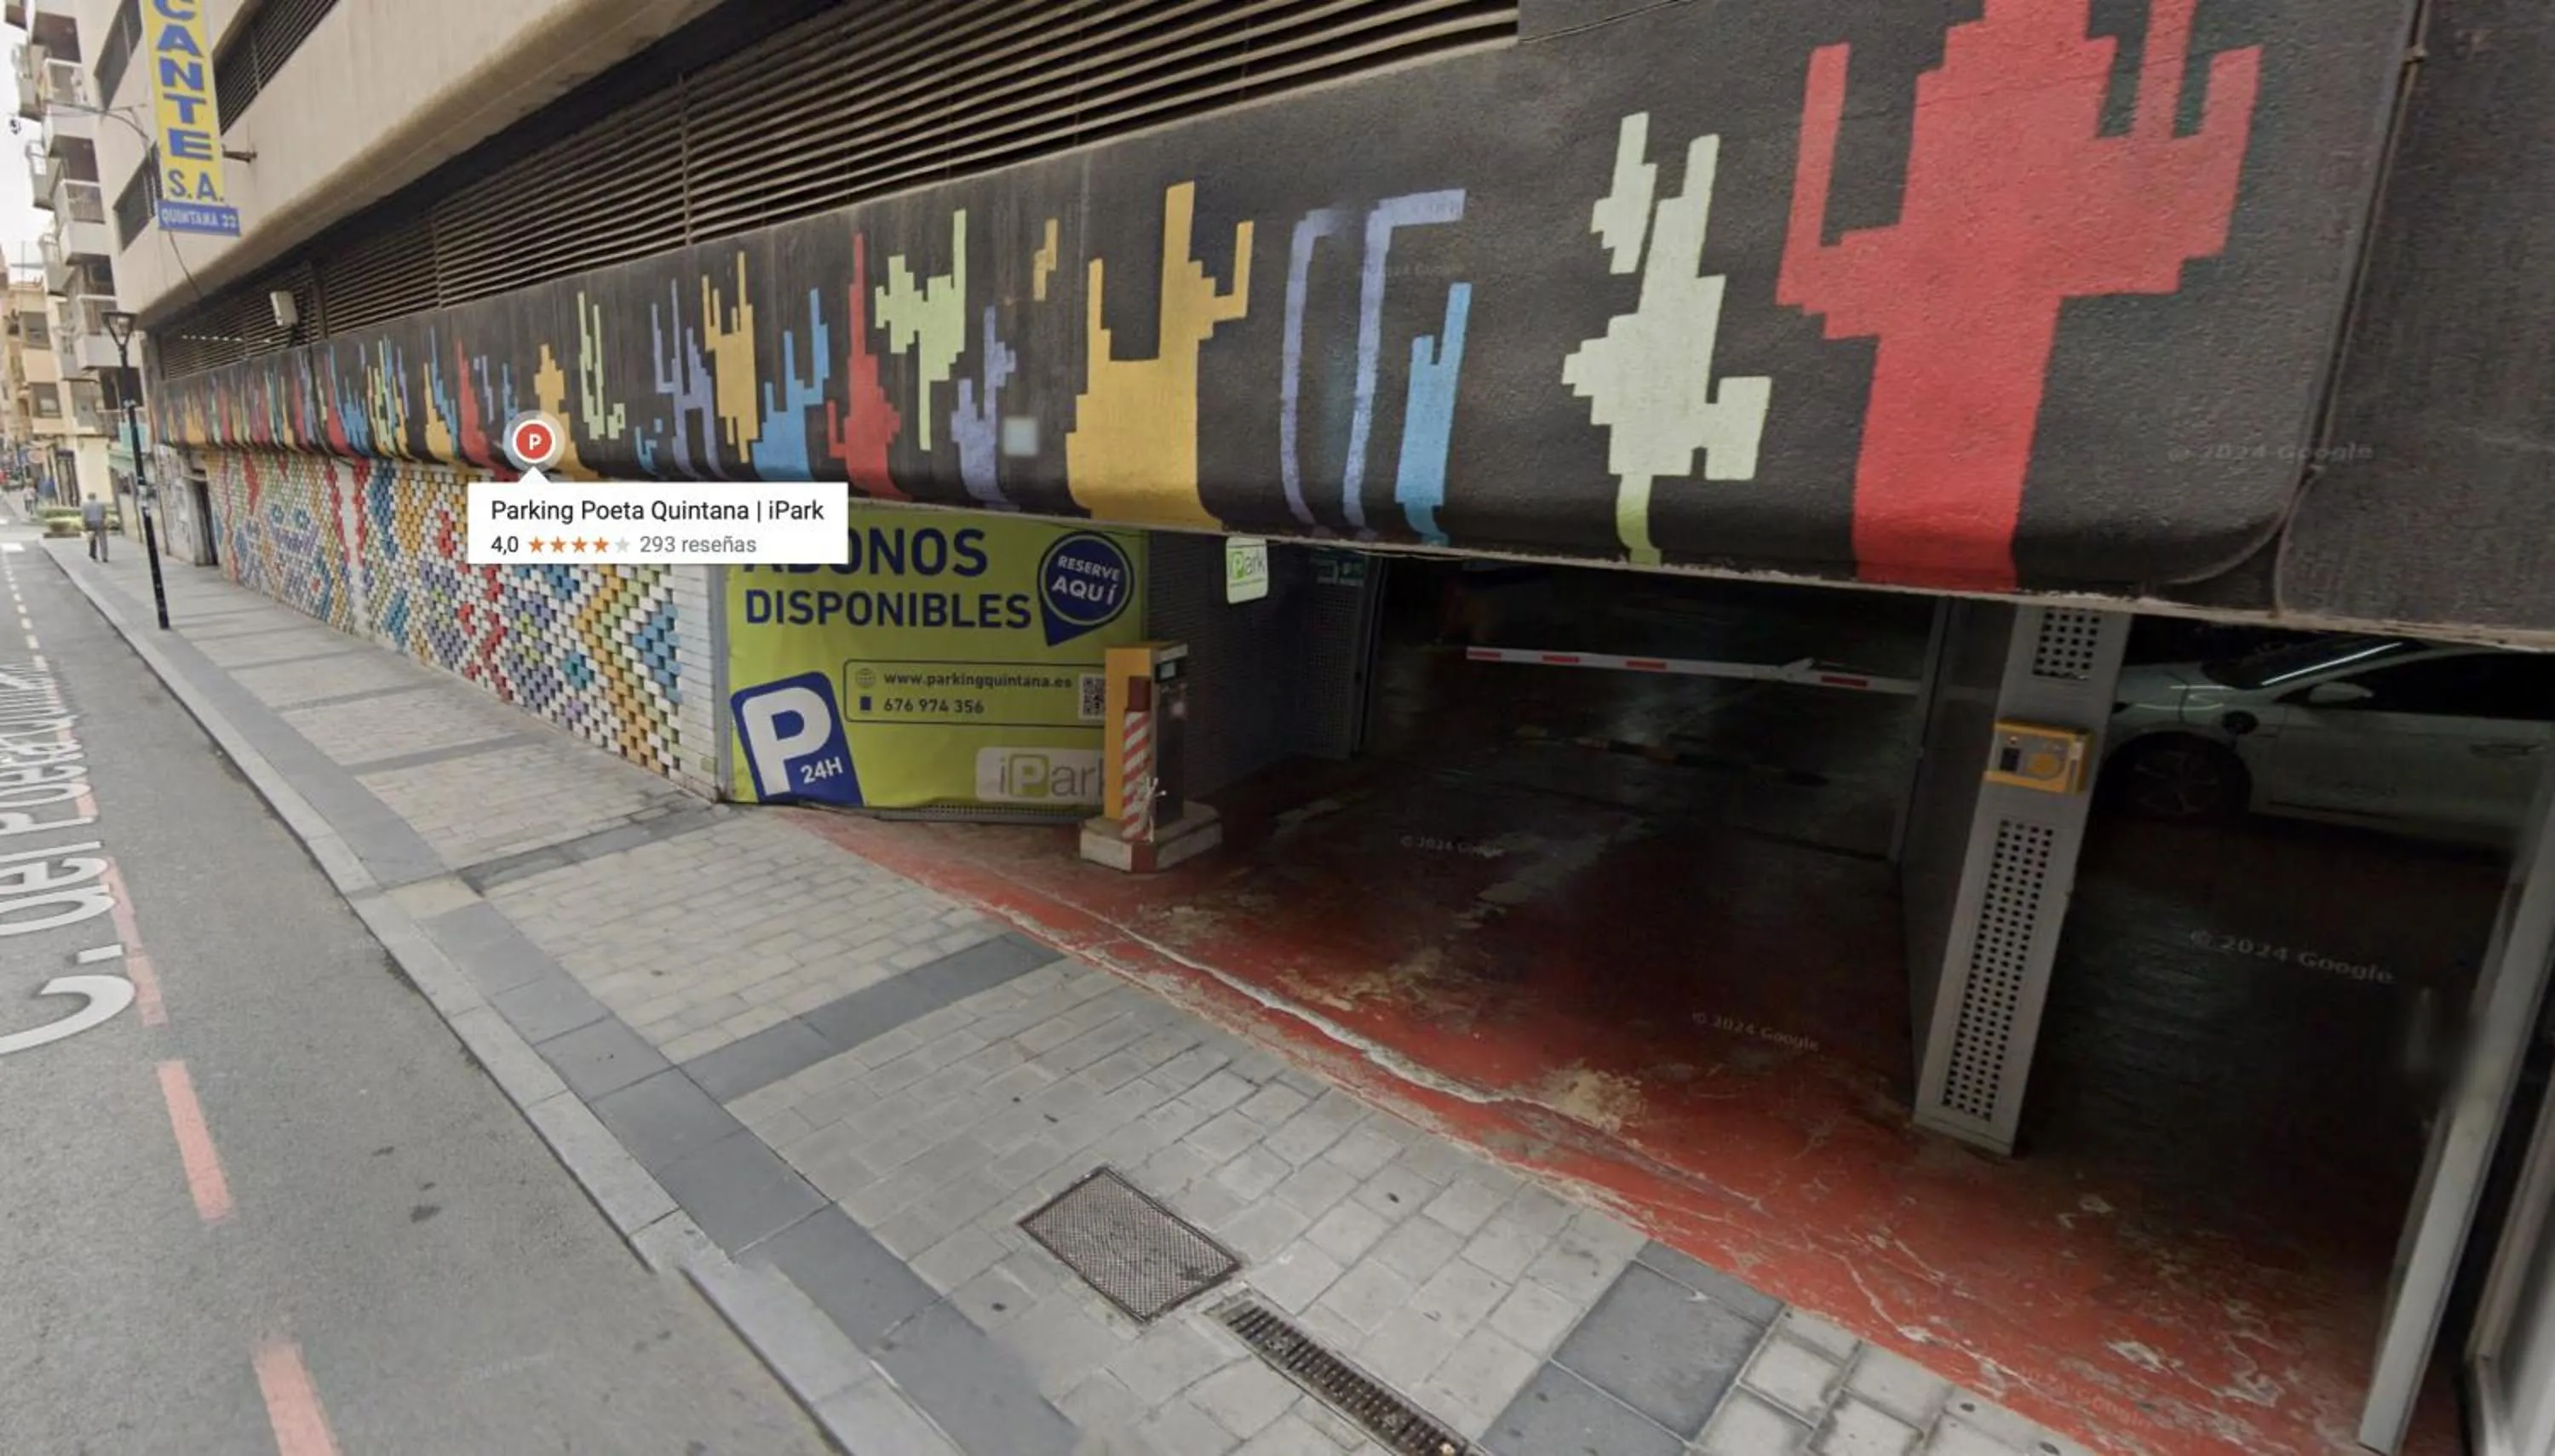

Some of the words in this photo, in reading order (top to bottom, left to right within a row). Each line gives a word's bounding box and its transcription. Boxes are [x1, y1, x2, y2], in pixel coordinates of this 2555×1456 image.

[168, 169, 223, 202] S.A.
[743, 527, 988, 577] ONOS
[1058, 555, 1121, 582] RESERVE
[746, 589, 1032, 629] DISPONIBLES
[883, 673, 1073, 689] www.parkingquintana.es
[883, 697, 915, 713] 676
[919, 698, 950, 713] 974
[953, 699, 985, 714] 356
[742, 686, 832, 797] P
[801, 756, 844, 784] 24H
